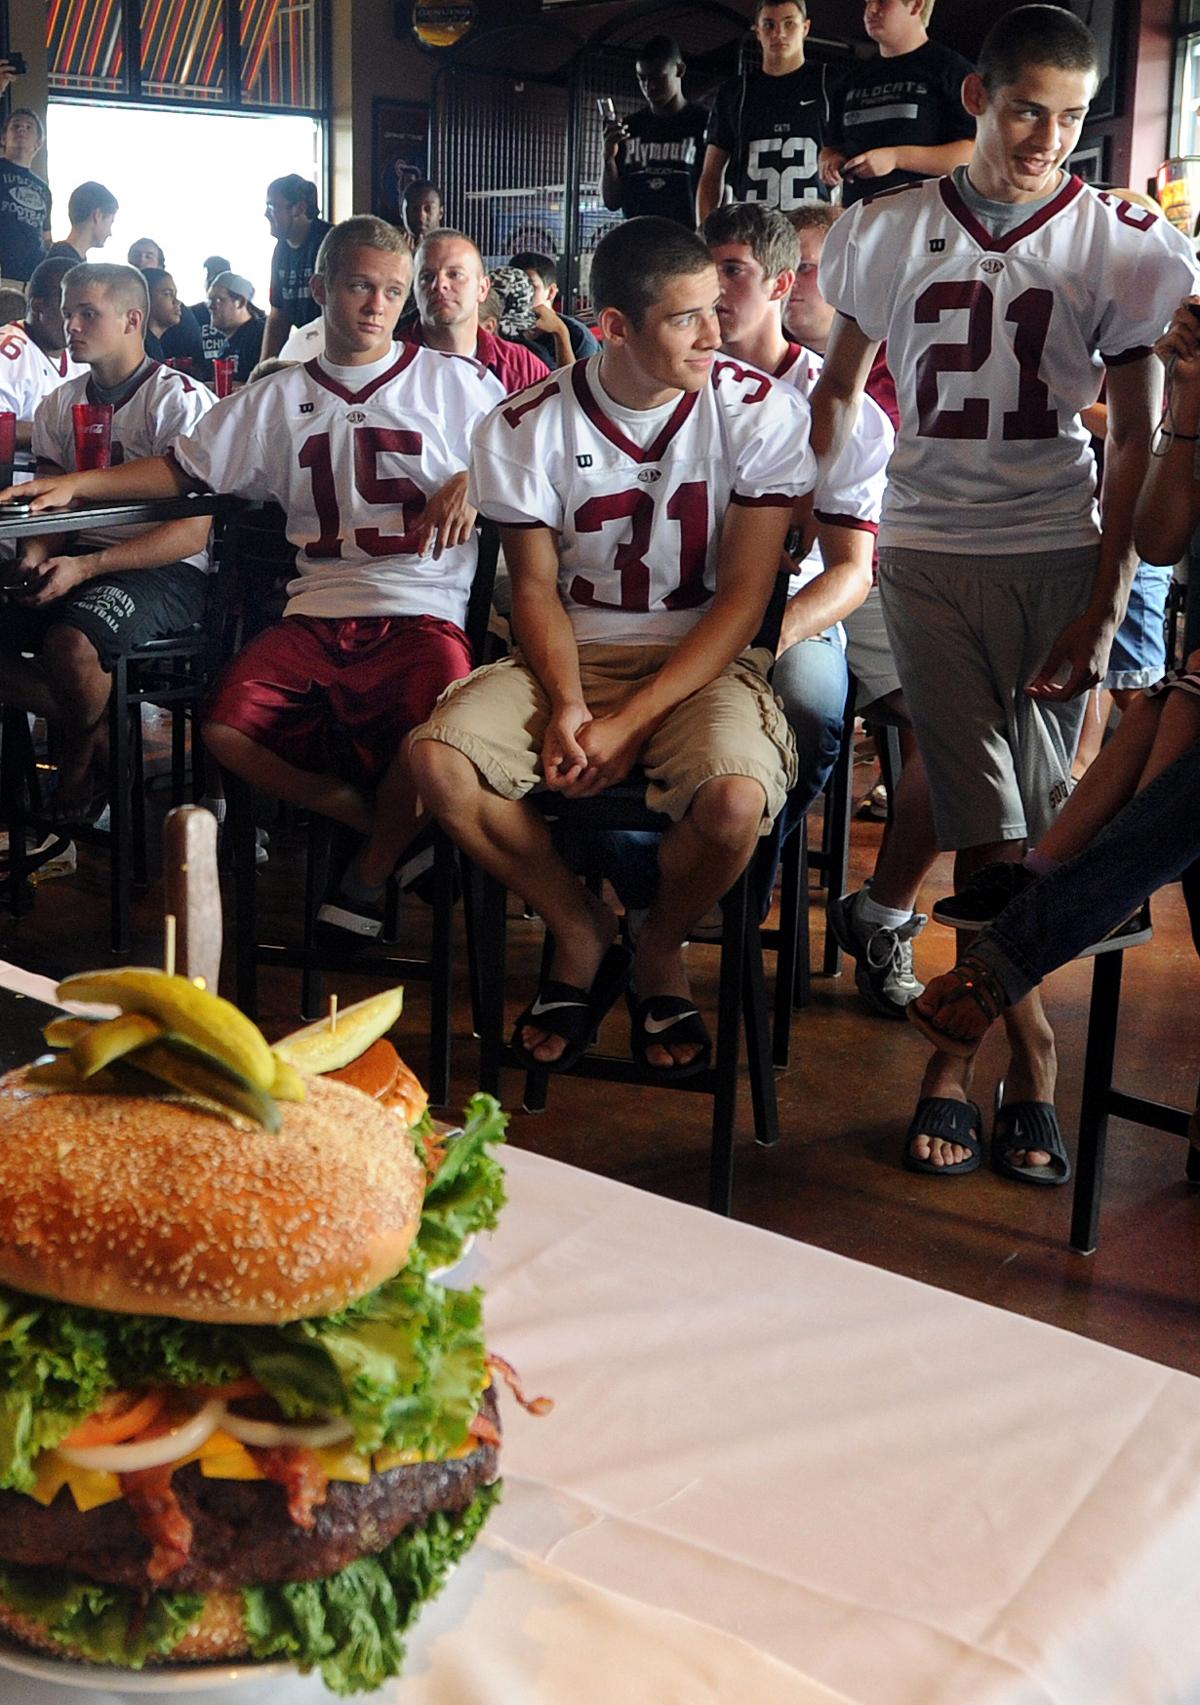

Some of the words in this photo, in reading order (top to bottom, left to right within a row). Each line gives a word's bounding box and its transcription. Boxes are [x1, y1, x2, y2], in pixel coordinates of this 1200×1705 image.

[774, 123, 791, 133] CATS
[846, 80, 927, 101] WILDCATS
[625, 136, 697, 167] Plymouth
[746, 136, 818, 211] 52
[913, 280, 1059, 440] 21
[298, 427, 427, 558] 15
[569, 481, 715, 613] 31
